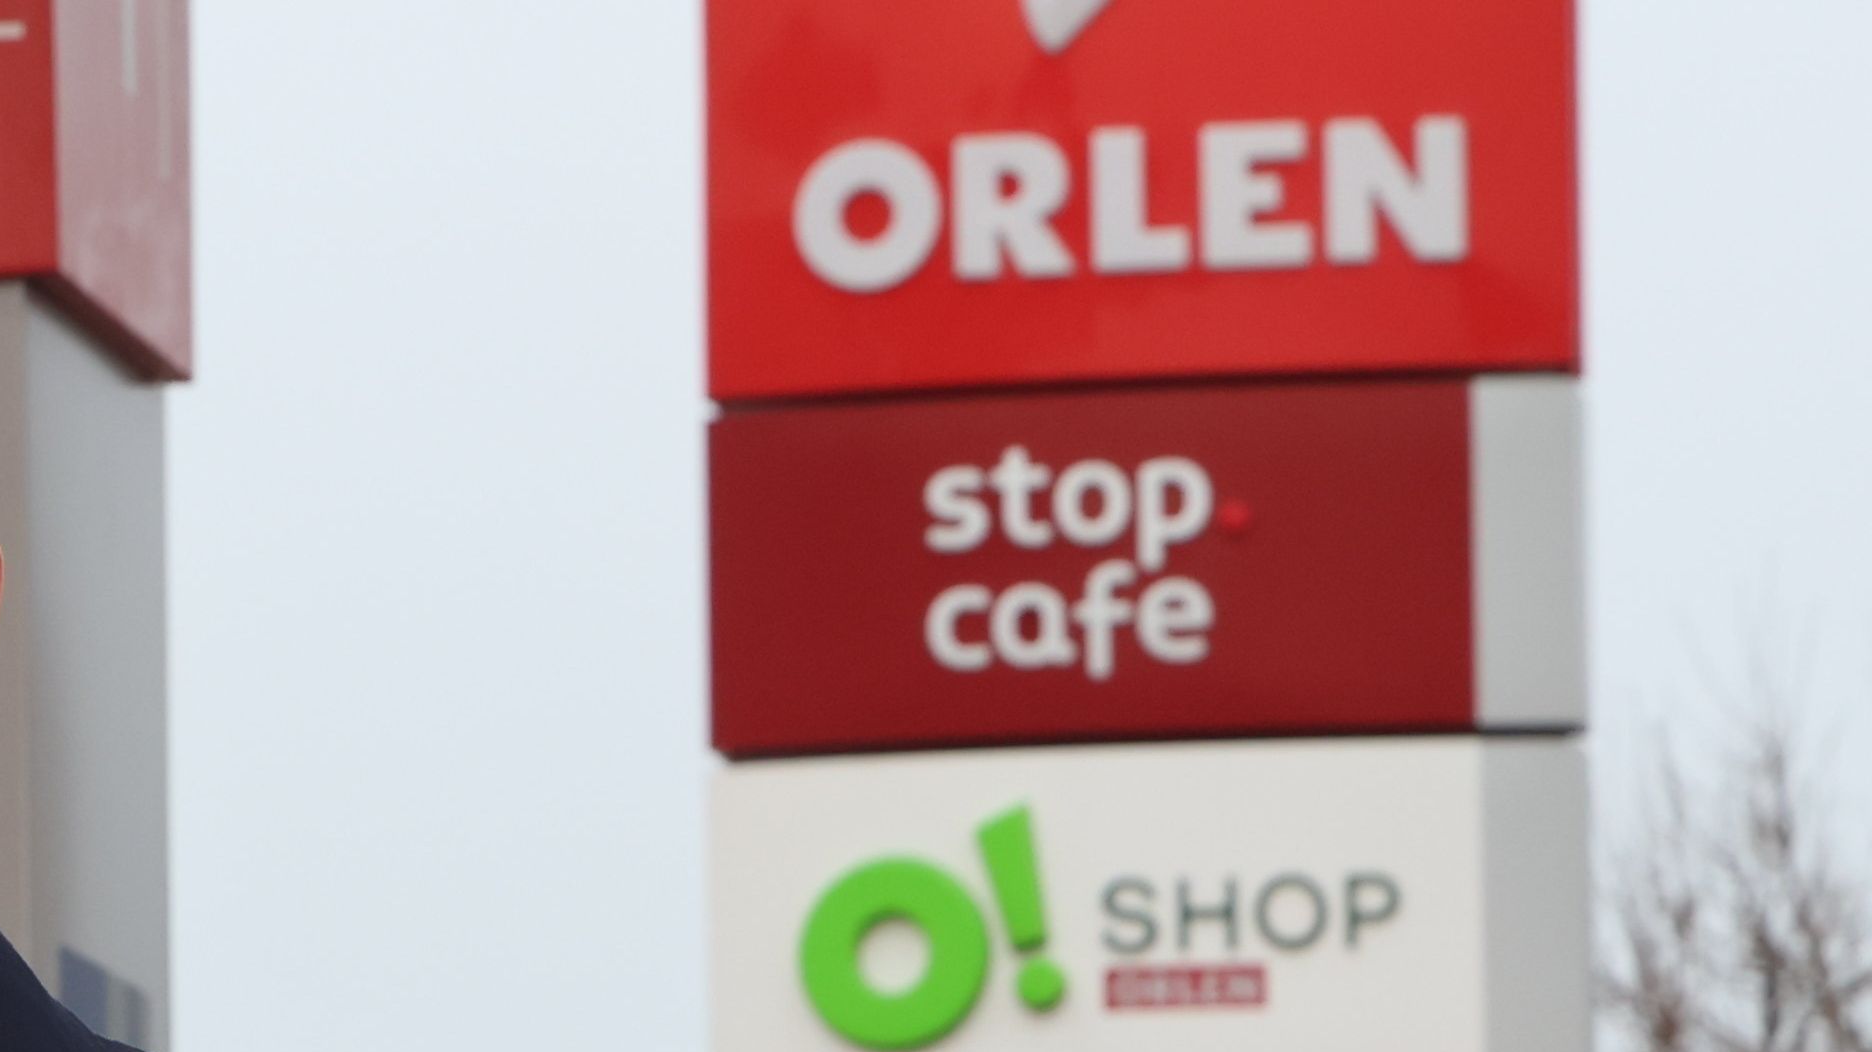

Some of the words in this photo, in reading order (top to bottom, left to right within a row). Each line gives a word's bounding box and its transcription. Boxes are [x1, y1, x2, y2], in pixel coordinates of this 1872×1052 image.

[791, 114, 1469, 293] ORLEN
[924, 446, 1215, 571] stop
[925, 559, 1215, 681] cafe
[1101, 873, 1402, 955] SHOP
